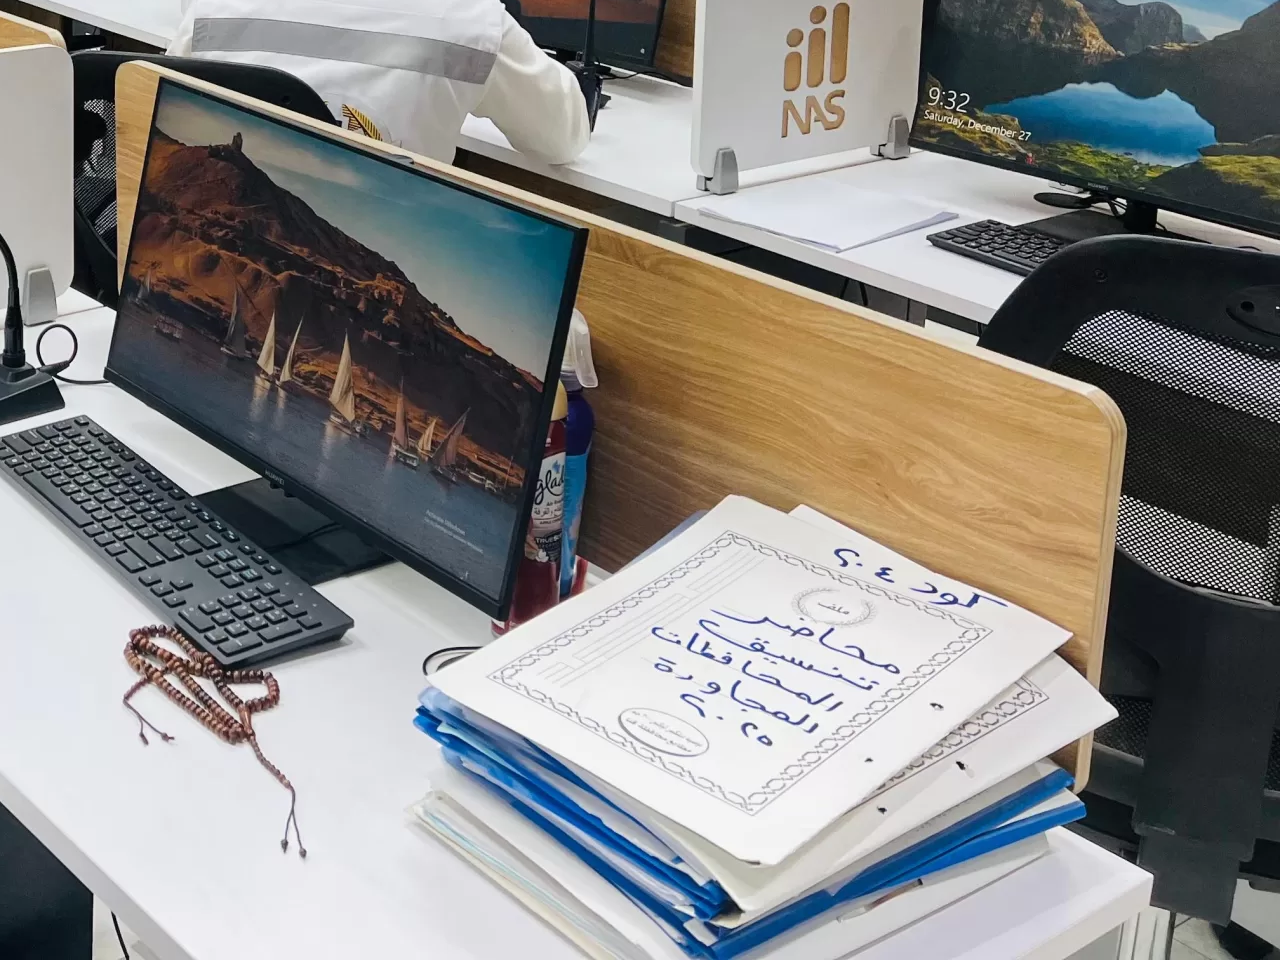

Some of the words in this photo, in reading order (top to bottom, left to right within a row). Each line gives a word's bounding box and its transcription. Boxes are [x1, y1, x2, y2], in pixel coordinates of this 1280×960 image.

[781, 90, 846, 138] NAS
[927, 87, 970, 113] 9:32
[924, 110, 964, 128] Saturday,
[968, 119, 1016, 138] December
[1018, 130, 1031, 141] 27
[534, 466, 565, 505] glad
[817, 602, 851, 615] ملف
[909, 582, 1008, 608] كود
[698, 619, 880, 691] تنسيق
[710, 609, 900, 674] محاضر
[651, 626, 843, 712] المحافظات
[654, 657, 819, 734] المجاورة
